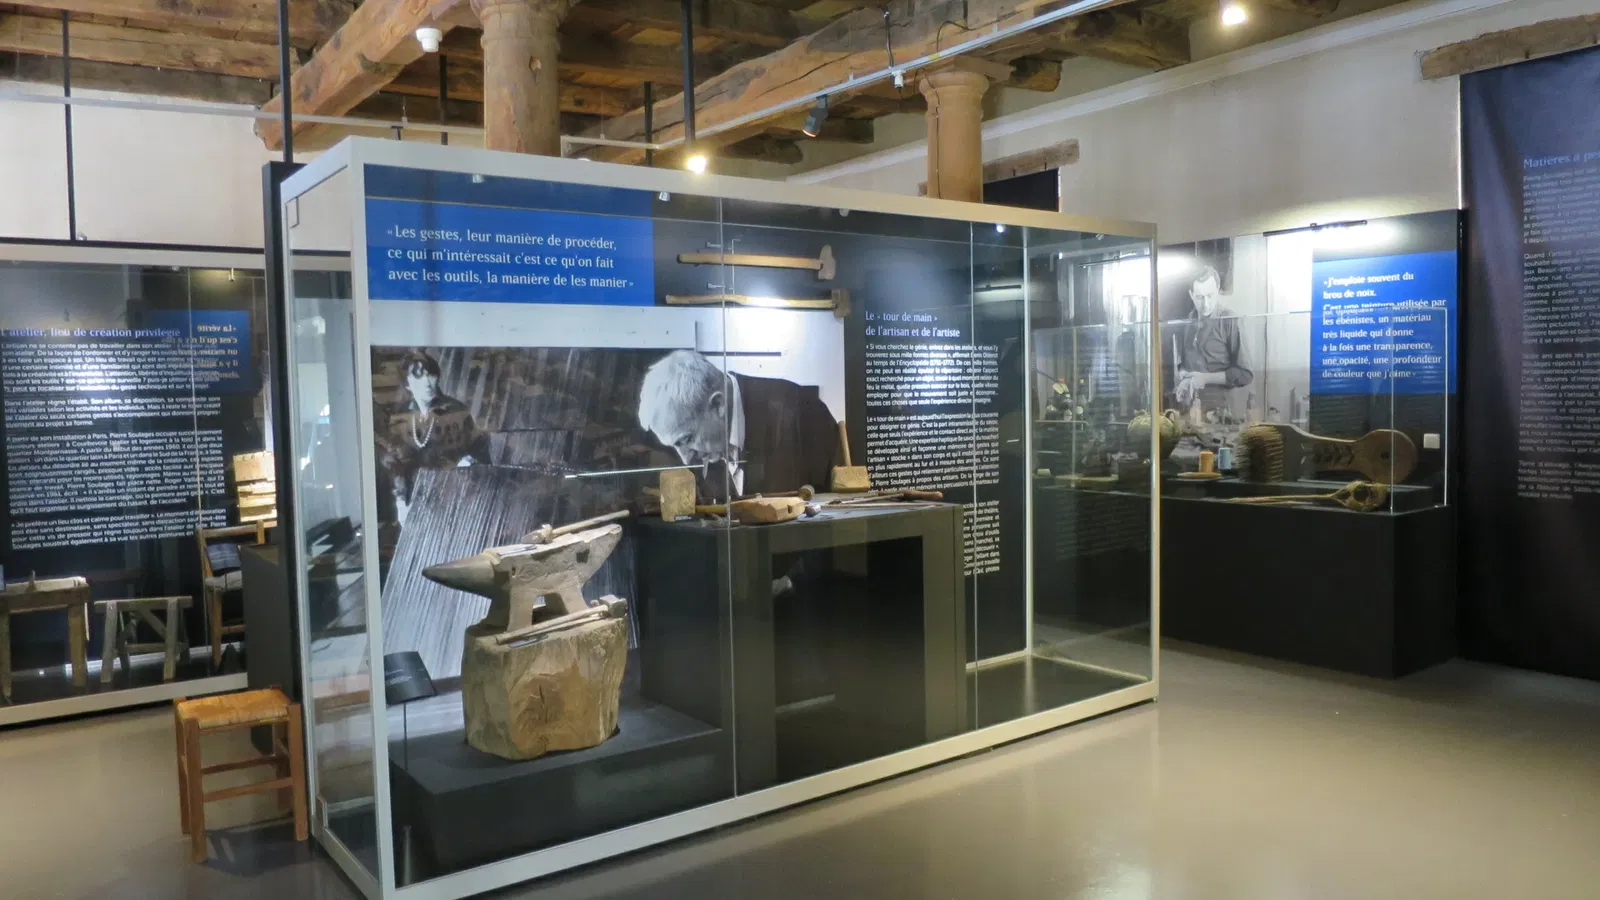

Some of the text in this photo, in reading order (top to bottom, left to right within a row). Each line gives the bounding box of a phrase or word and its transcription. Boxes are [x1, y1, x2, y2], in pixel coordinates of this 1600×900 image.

[420, 229, 462, 242] gestes,
[467, 229, 492, 241] leur
[496, 232, 543, 245] manière
[547, 234, 562, 246] de
[565, 237, 617, 250] procéder,
[388, 248, 614, 269] ce qui m'intéressait c'est ce qu'on fait
[388, 270, 418, 280] avec
[422, 269, 440, 281] les
[444, 270, 482, 284] outils,
[487, 271, 498, 283] la
[502, 273, 549, 285] manière
[553, 274, 567, 286] de
[571, 275, 587, 286] les
[1367, 274, 1400, 283] souvent
[1403, 272, 1414, 280] du
[1324, 291, 1342, 299] brou
[1344, 290, 1354, 298] de
[1396, 299, 1428, 307] utilisée
[1431, 299, 1446, 307] par
[865, 310, 874, 320] Le
[883, 312, 899, 321] tour
[902, 312, 911, 321] de
[913, 313, 932, 322] main
[1323, 316, 1335, 325] les
[1336, 314, 1375, 325] ébénistes,
[1392, 314, 1431, 322] matériau
[50, 328, 70, 336] lieu
[74, 328, 86, 336] de
[90, 328, 131, 336] création
[866, 326, 960, 337] de l'artisan et de l'artiste
[1340, 329, 1367, 339] liquide
[1370, 329, 1382, 338] qui
[1386, 328, 1414, 336] donne
[1330, 343, 1336, 351] la
[1340, 342, 1353, 351] fois
[1340, 356, 1370, 365] opacité,
[1322, 370, 1331, 378] de
[1367, 370, 1381, 378] que
